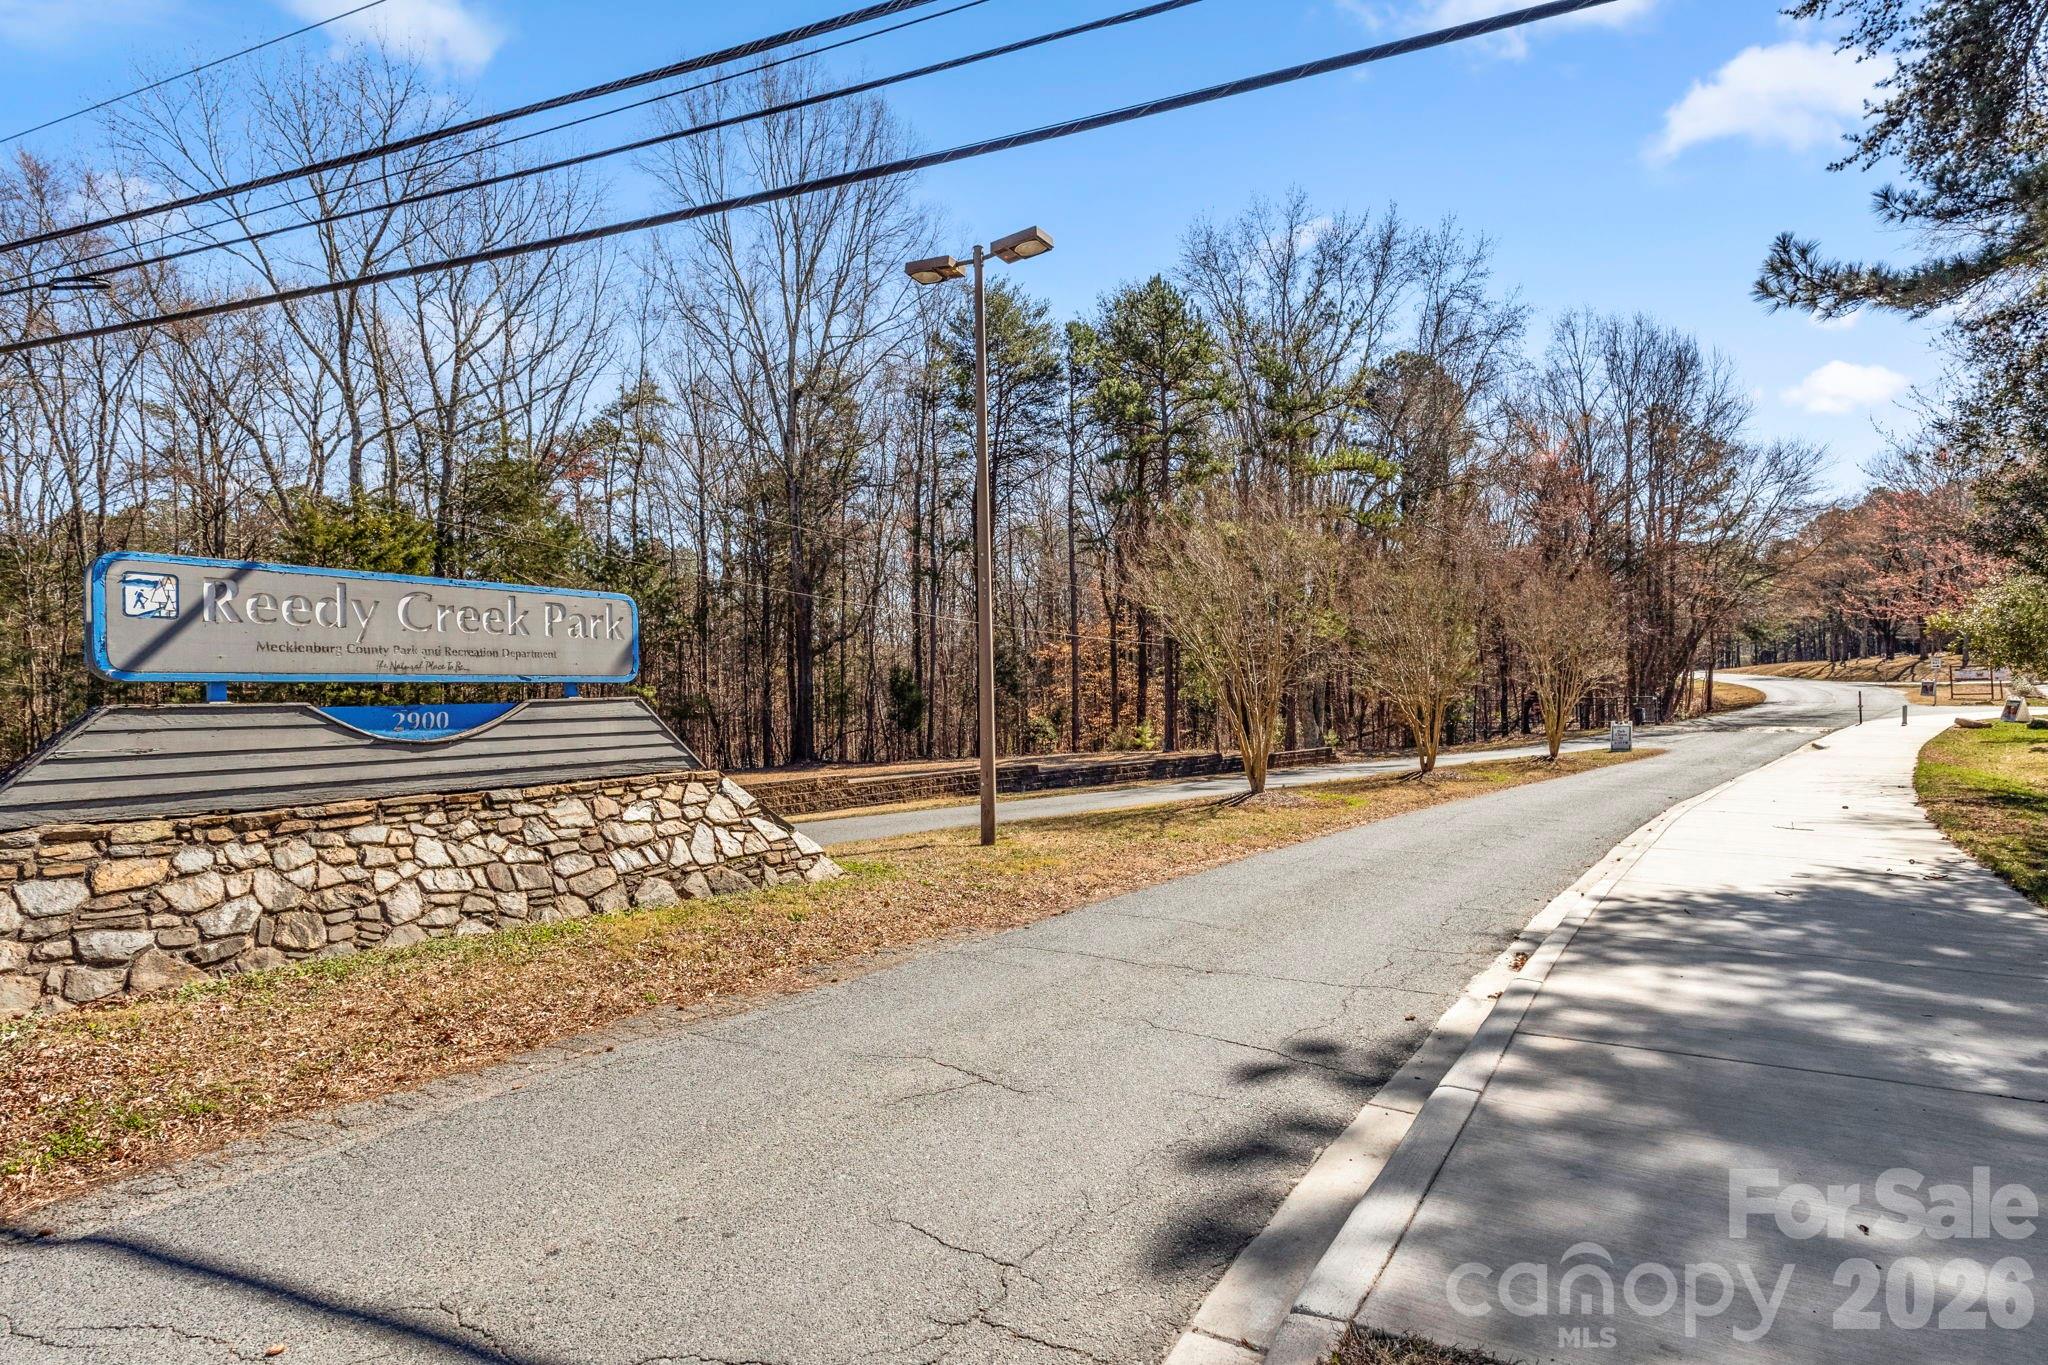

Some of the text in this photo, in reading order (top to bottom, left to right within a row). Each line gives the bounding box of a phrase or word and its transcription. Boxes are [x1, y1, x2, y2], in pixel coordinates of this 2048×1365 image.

[203, 577, 625, 643] Reedy Creek Park
[256, 641, 558, 660] Mecklenburg County Park and Recreation Department
[392, 711, 450, 732] 2900
